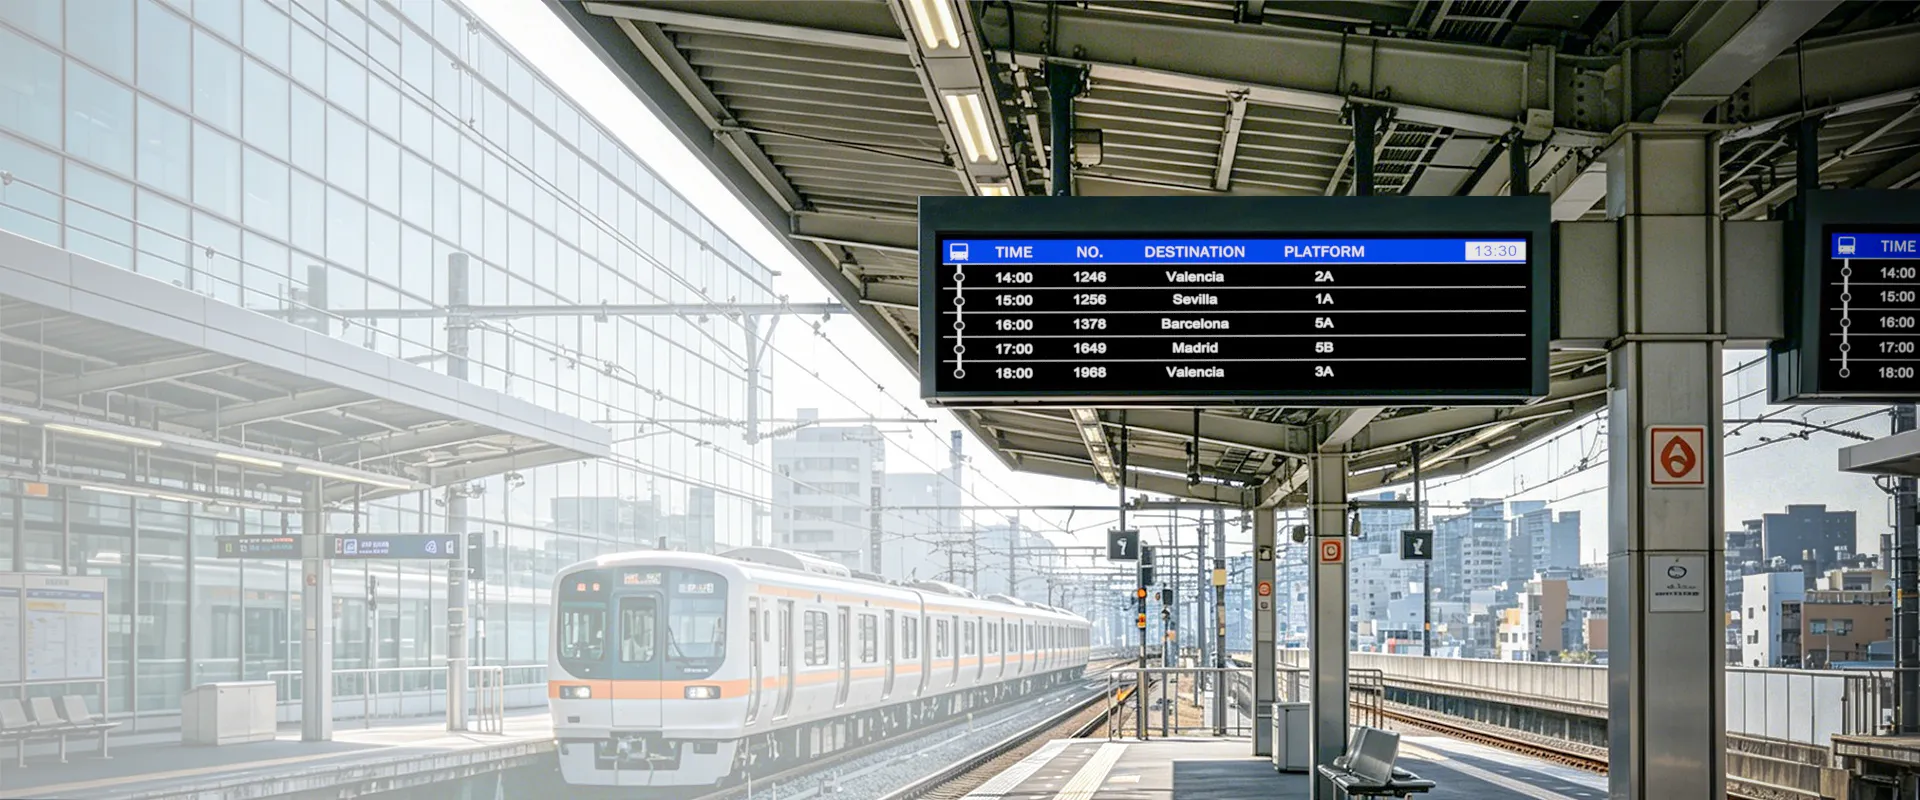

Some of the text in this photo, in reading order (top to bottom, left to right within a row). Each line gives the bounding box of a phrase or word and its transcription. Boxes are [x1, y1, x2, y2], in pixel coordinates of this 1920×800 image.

[995, 245, 1365, 258] TIME NO. DESTINATION PLATFORM
[1475, 245, 1517, 257] 13:30
[1881, 240, 1917, 252] TIME
[995, 270, 1334, 283] 14:00 1246 Valencia 2A
[1880, 267, 1916, 279] 14:00
[995, 293, 1334, 307] 15:00 1256 Sevilla 1A
[1880, 291, 1915, 302] 15:00
[995, 317, 1334, 331] 16:00 1378 Barcelona 5A
[1879, 316, 1915, 328] 16:00
[995, 341, 1334, 355] 17:00 1649 Madrid 5B
[1879, 341, 1914, 353] 17:00
[995, 365, 1334, 379] 18:00 1968 Valencia 3A
[1878, 367, 1914, 378] 18:00
